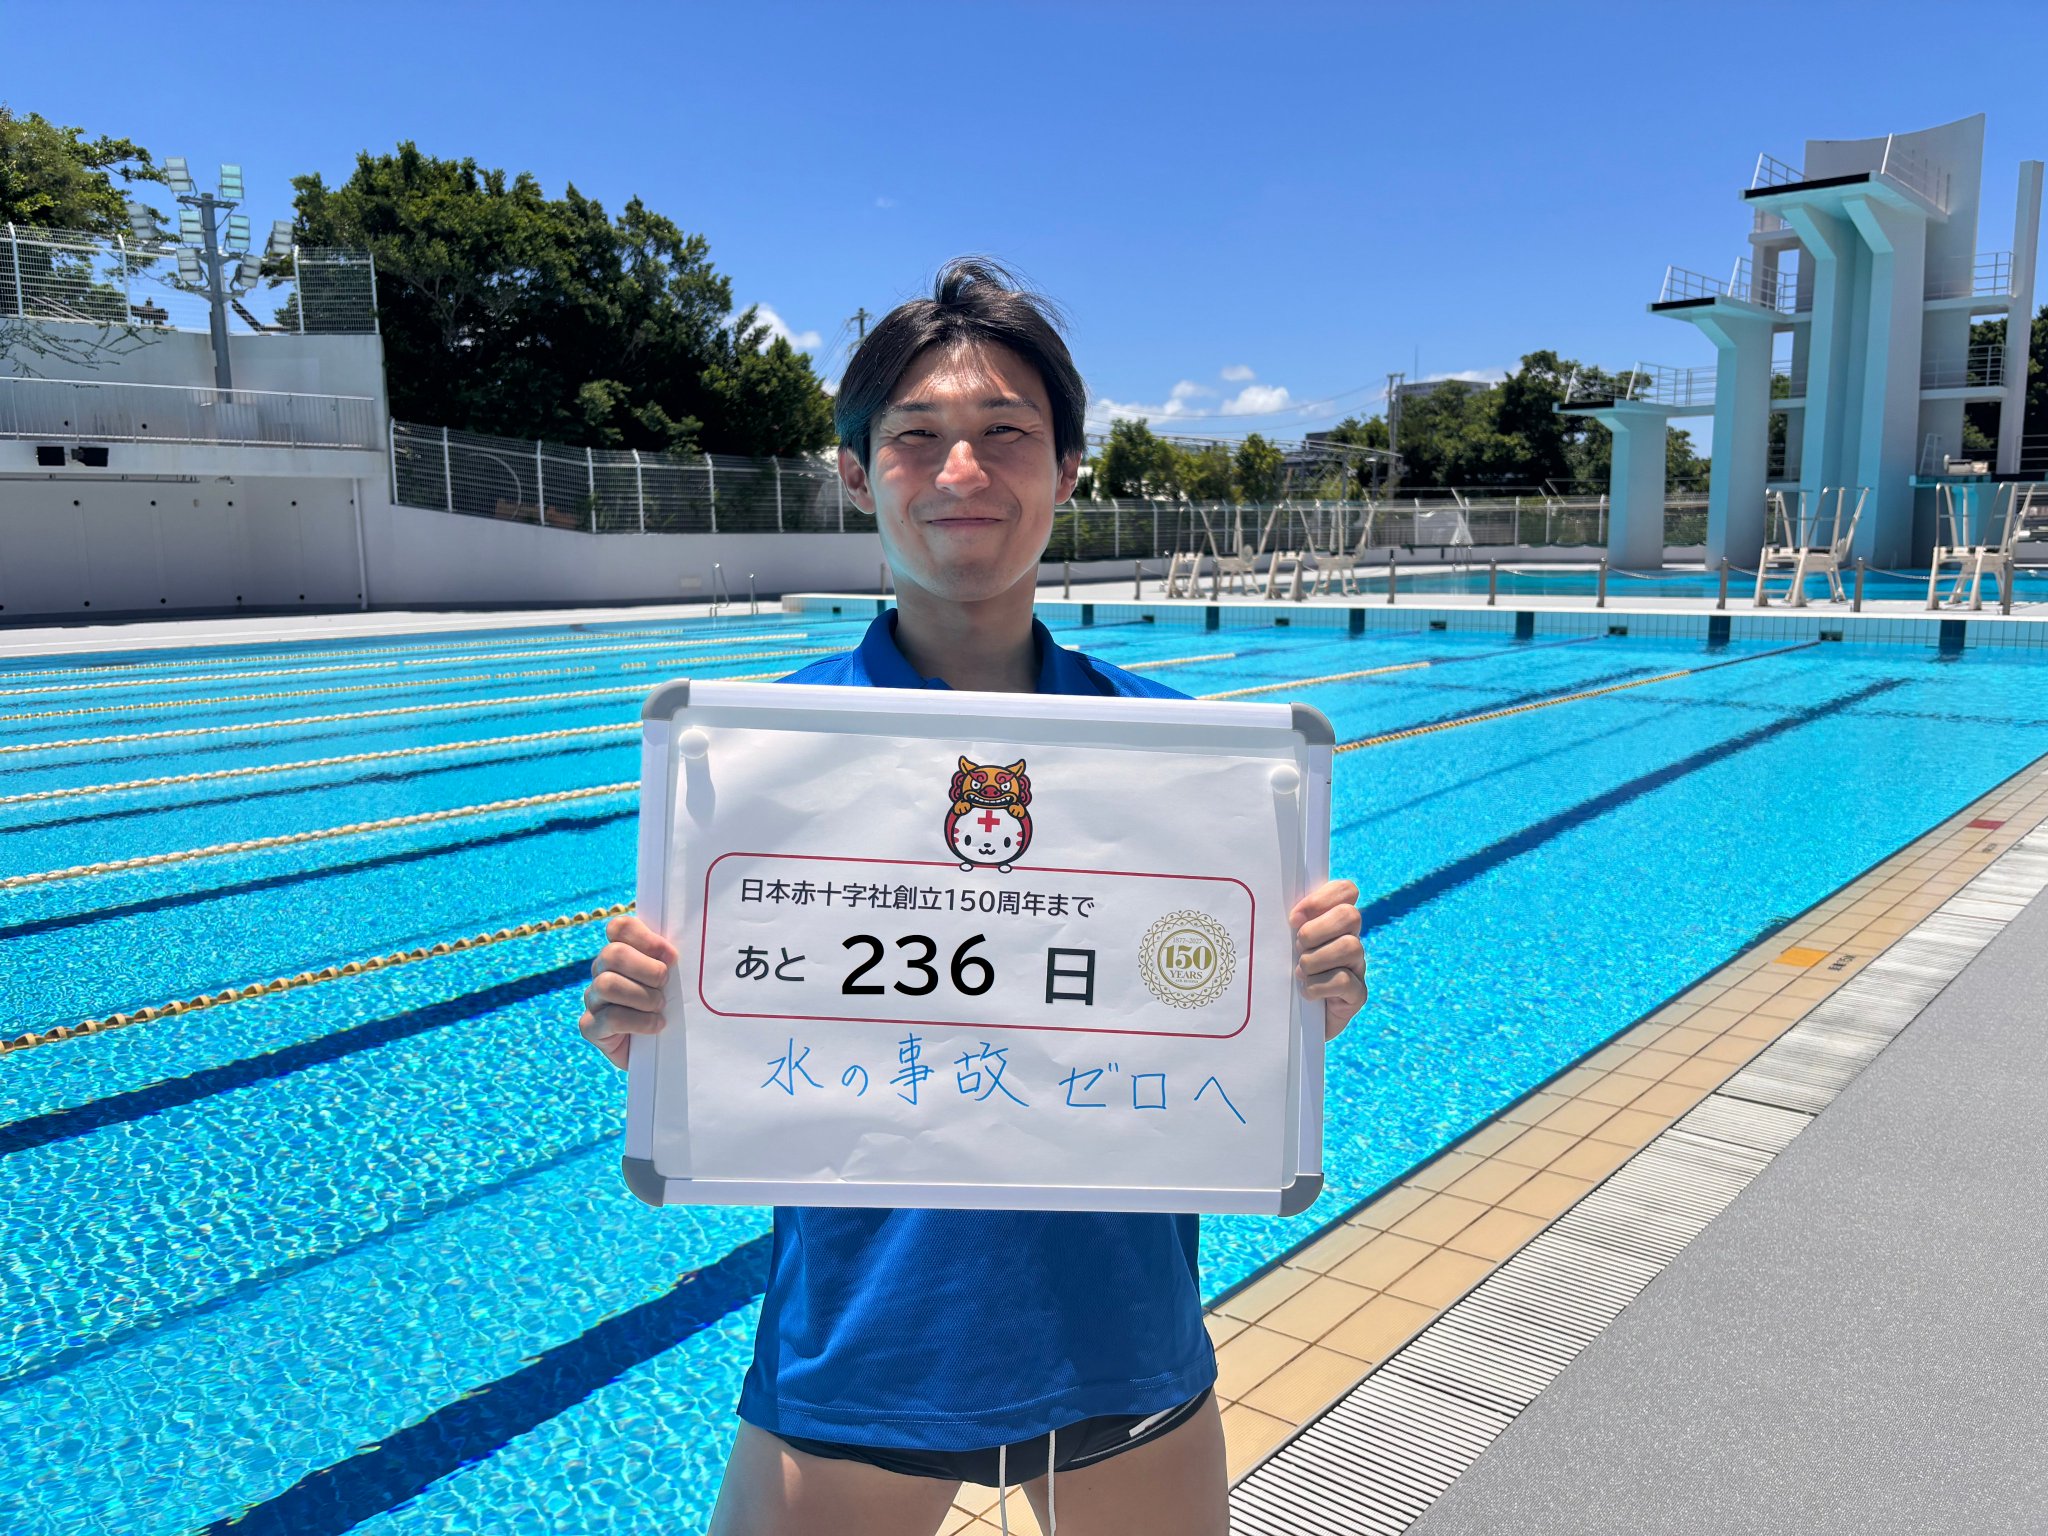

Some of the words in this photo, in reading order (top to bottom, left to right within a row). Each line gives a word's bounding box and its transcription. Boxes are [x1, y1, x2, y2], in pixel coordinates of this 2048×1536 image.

[742, 879, 1095, 918] 日本赤十字社創立150周年まで
[736, 946, 805, 982] あと
[842, 933, 995, 996] 236
[1045, 947, 1096, 1006] 日
[1164, 945, 1212, 970] 150
[1170, 970, 1203, 979] YEARS
